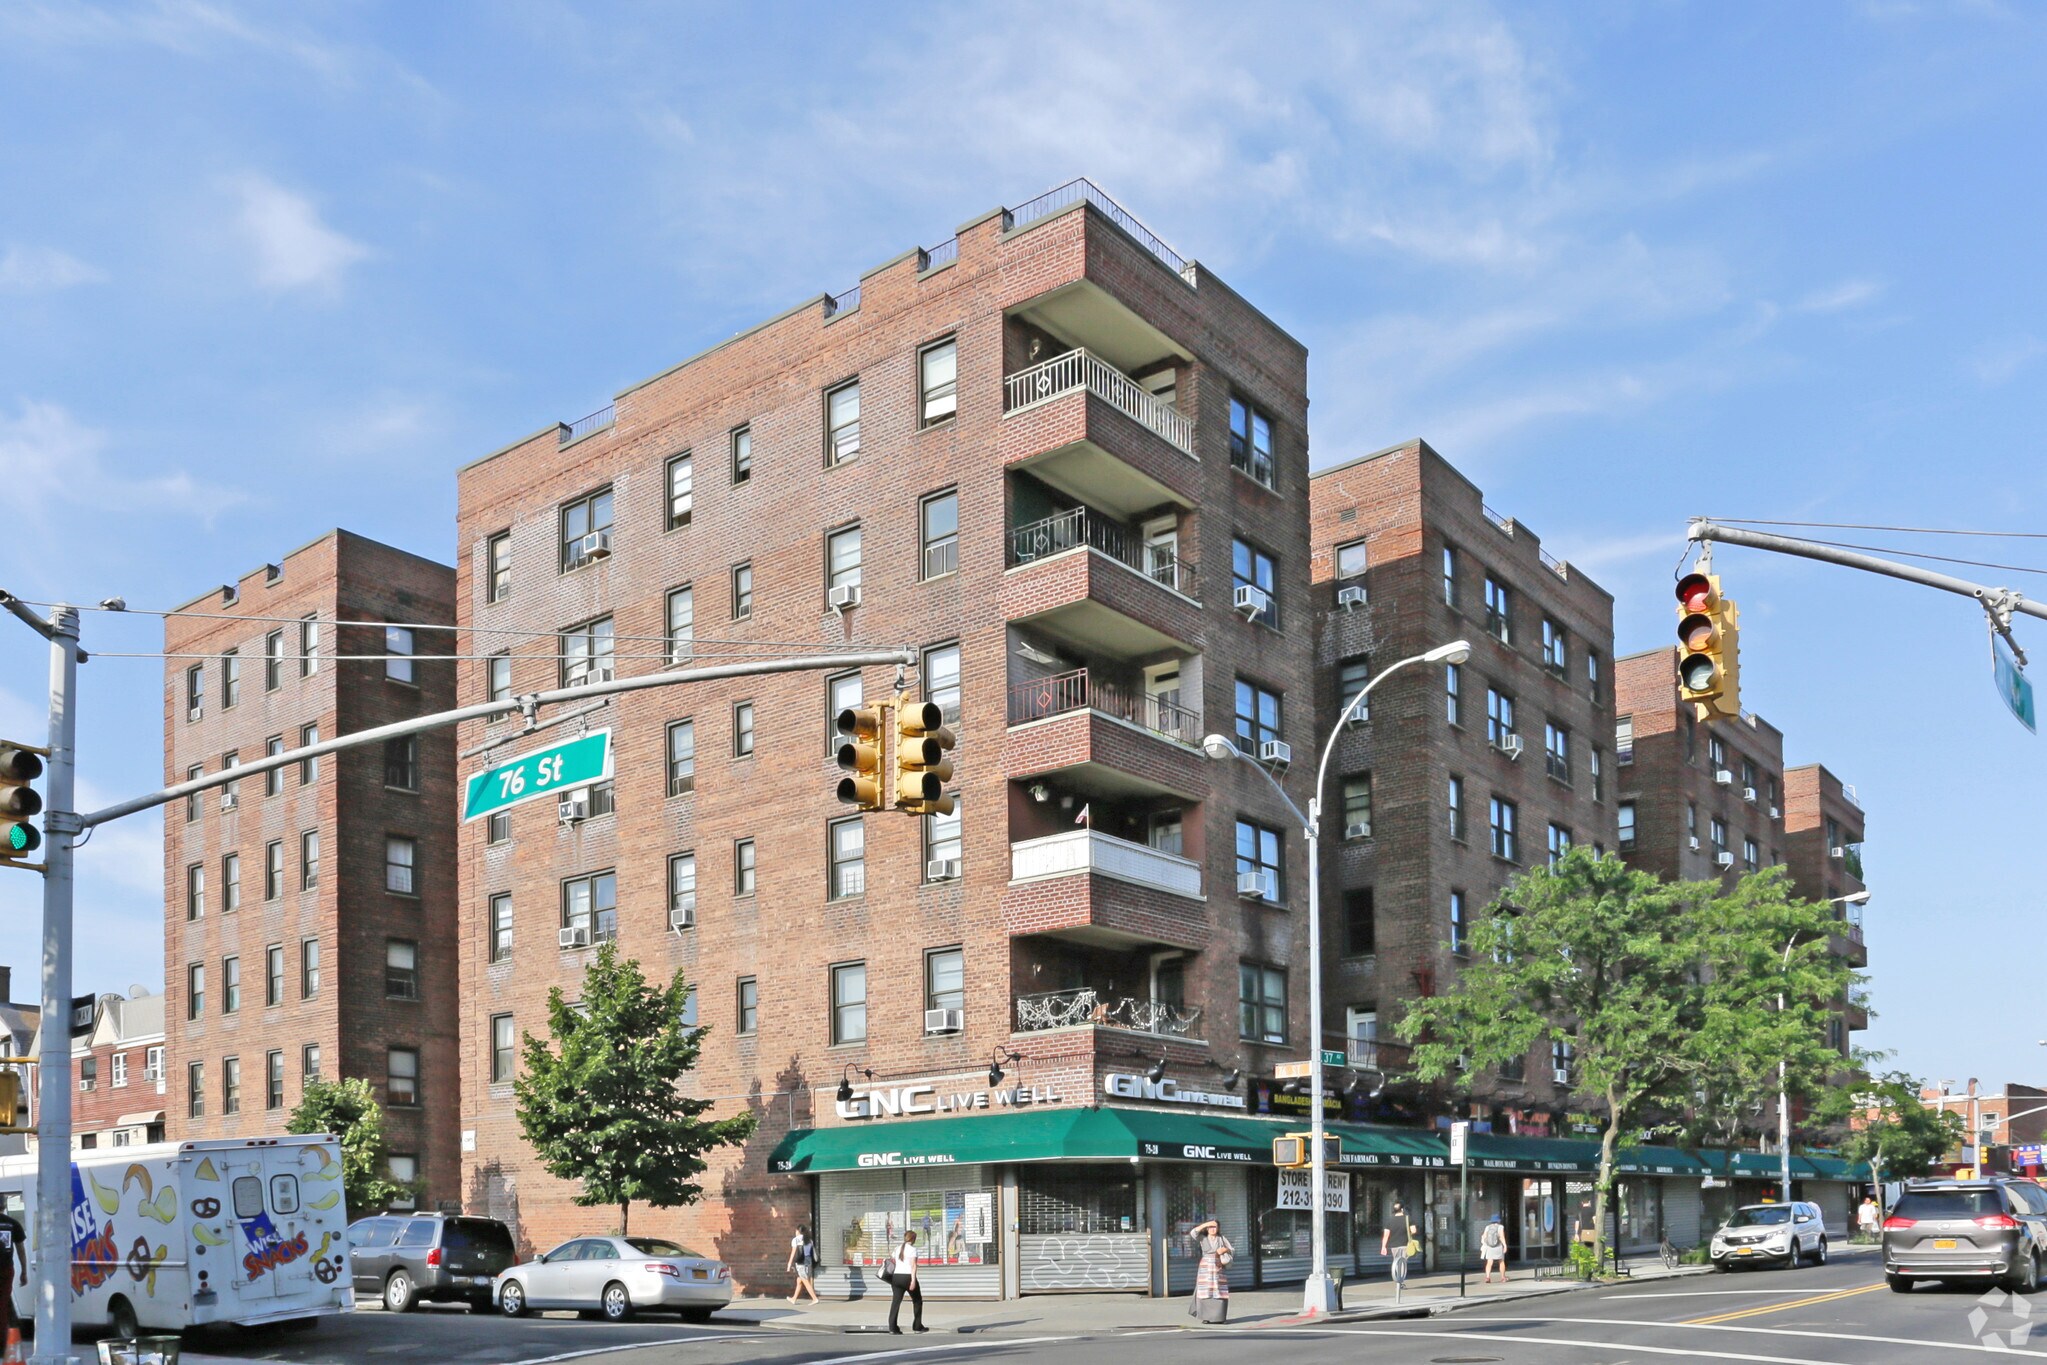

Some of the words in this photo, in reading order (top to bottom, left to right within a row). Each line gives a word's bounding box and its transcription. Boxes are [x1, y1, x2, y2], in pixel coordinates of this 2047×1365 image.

[499, 765, 525, 798] 76
[536, 753, 563, 786] St
[1324, 1052, 1333, 1063] 37
[1105, 1073, 1177, 1101] GNC
[836, 1086, 931, 1118] GNC
[938, 1092, 988, 1110] LIVE
[995, 1086, 1060, 1104] WELL
[858, 1152, 901, 1167] GNC
[903, 1156, 925, 1165] LIVE
[928, 1154, 955, 1163] WELL
[1183, 1145, 1216, 1159] GNC
[1216, 1152, 1232, 1160] LIVE
[1233, 1153, 1252, 1161] WELL
[1351, 1154, 1378, 1164] FARMACIA
[1425, 1156, 1430, 1167] &
[1281, 1170, 1308, 1187] STORE
[1327, 1174, 1347, 1190] RENT
[71, 1198, 96, 1244] ISE
[243, 1230, 309, 1281] SNACKS
